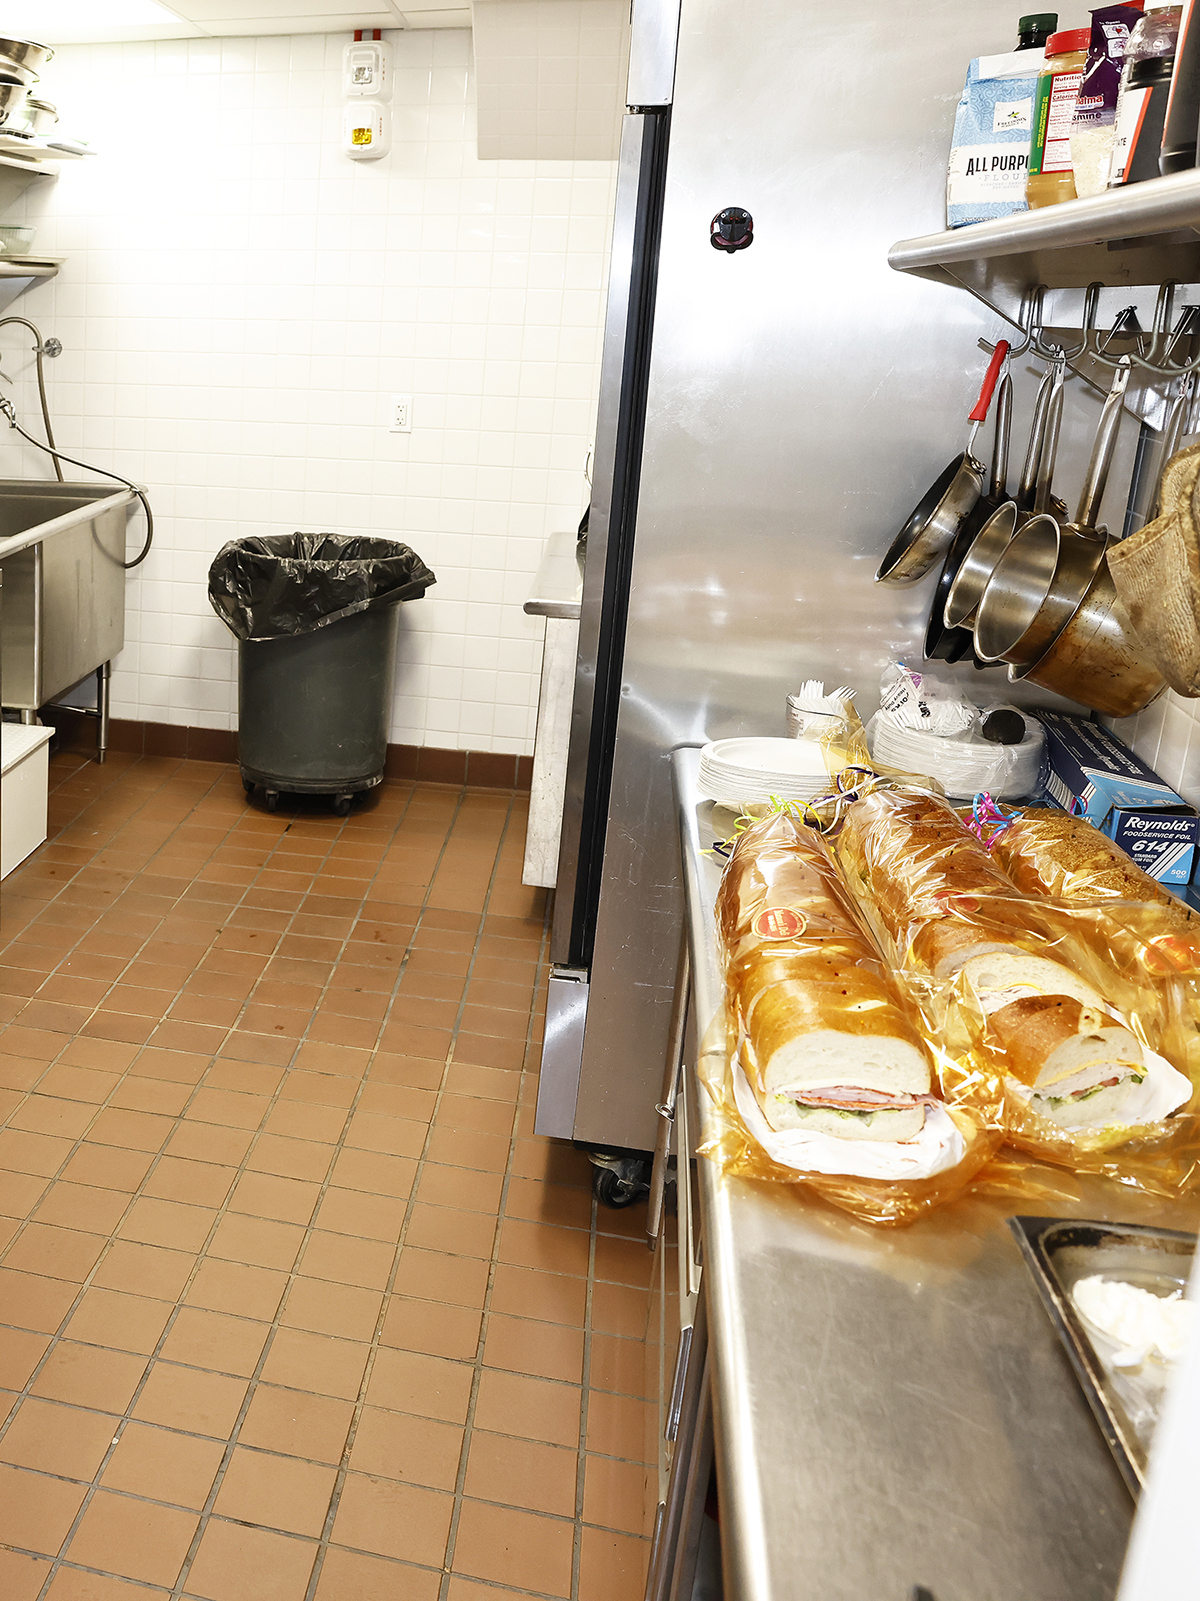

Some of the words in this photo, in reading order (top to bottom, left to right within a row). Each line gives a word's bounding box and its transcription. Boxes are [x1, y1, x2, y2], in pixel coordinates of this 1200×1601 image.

[1072, 112, 1102, 121] smine
[966, 157, 988, 176] ALL
[1124, 816, 1191, 832] Reynolds
[1122, 831, 1175, 839] FOODSERVICE
[1132, 840, 1170, 853] 614
